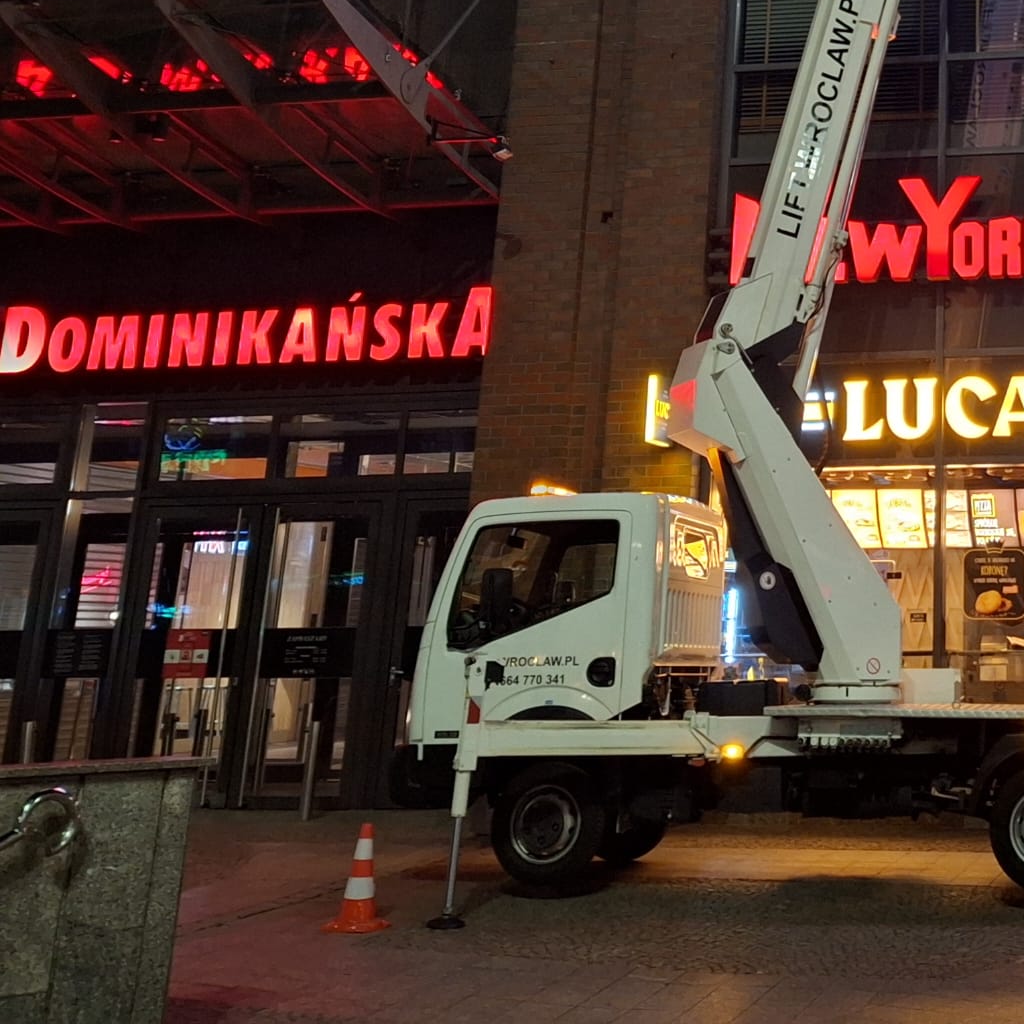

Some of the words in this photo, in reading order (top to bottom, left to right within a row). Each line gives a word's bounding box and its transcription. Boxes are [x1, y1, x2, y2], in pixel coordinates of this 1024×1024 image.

[0, 286, 493, 375] DOMINIKAŃSKA
[523, 674, 543, 686] 770
[546, 673, 565, 685] 341
